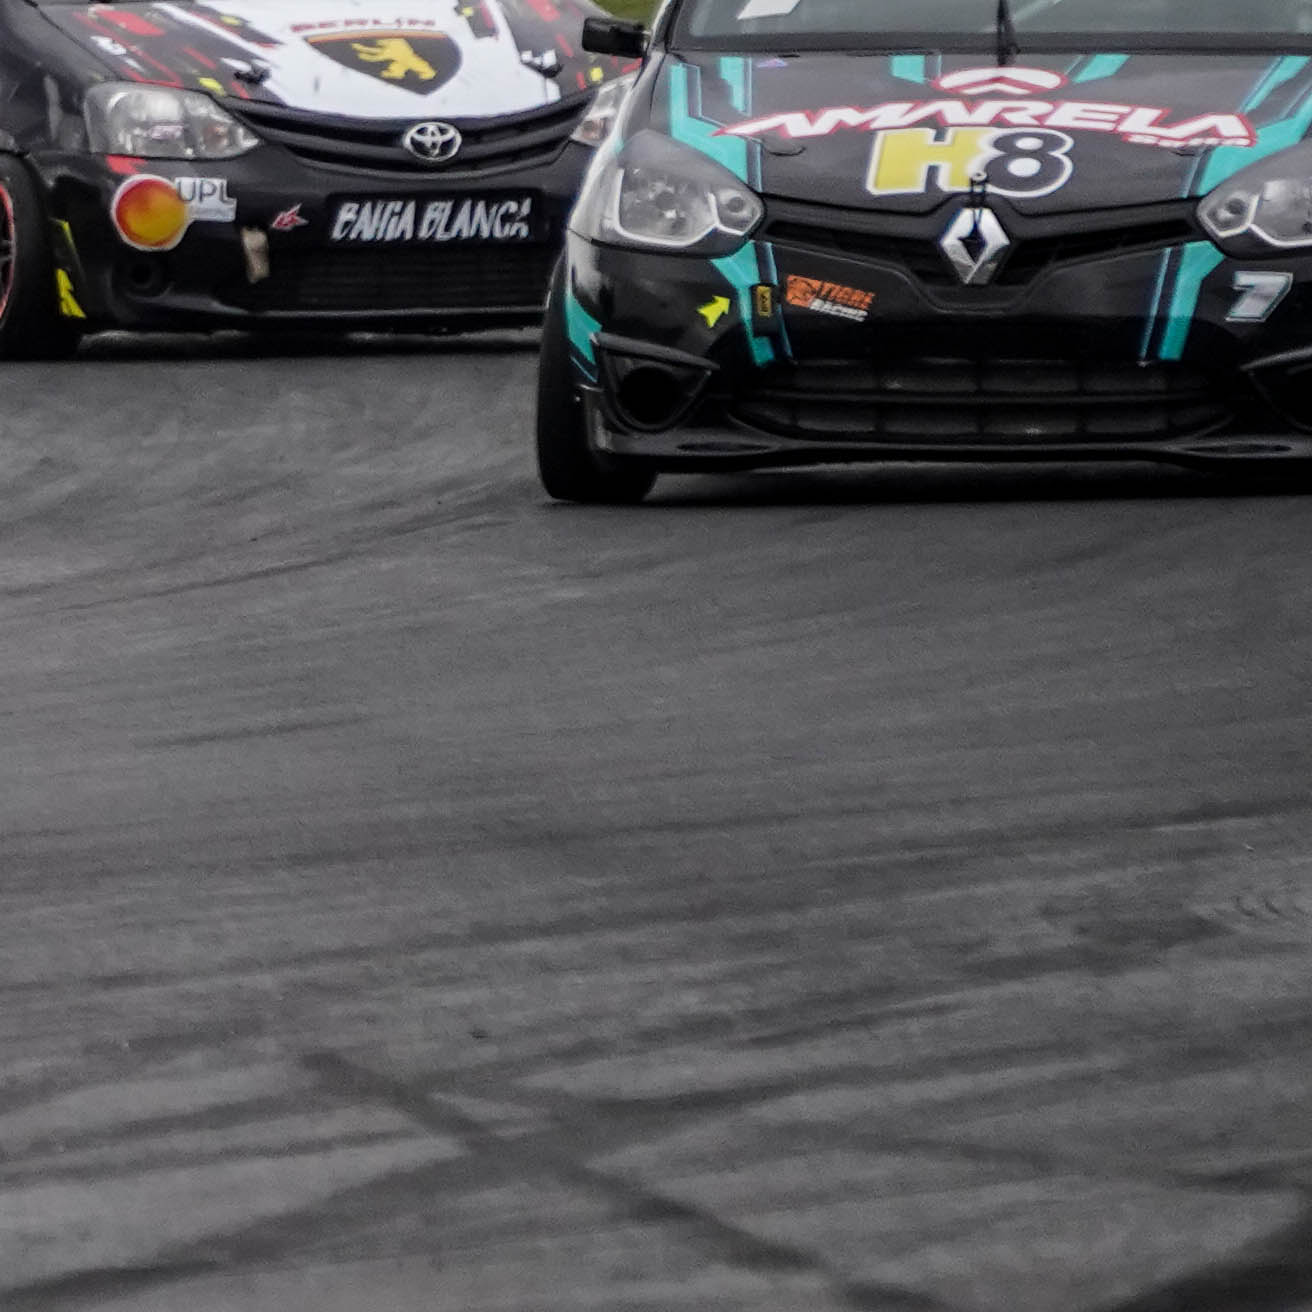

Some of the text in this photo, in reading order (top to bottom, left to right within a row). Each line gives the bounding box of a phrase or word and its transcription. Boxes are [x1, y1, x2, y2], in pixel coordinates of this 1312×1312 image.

[711, 99, 1256, 147] AMARELA
[865, 125, 1075, 199] H8
[177, 179, 237, 204] UPL
[1224, 270, 1294, 323] 7
